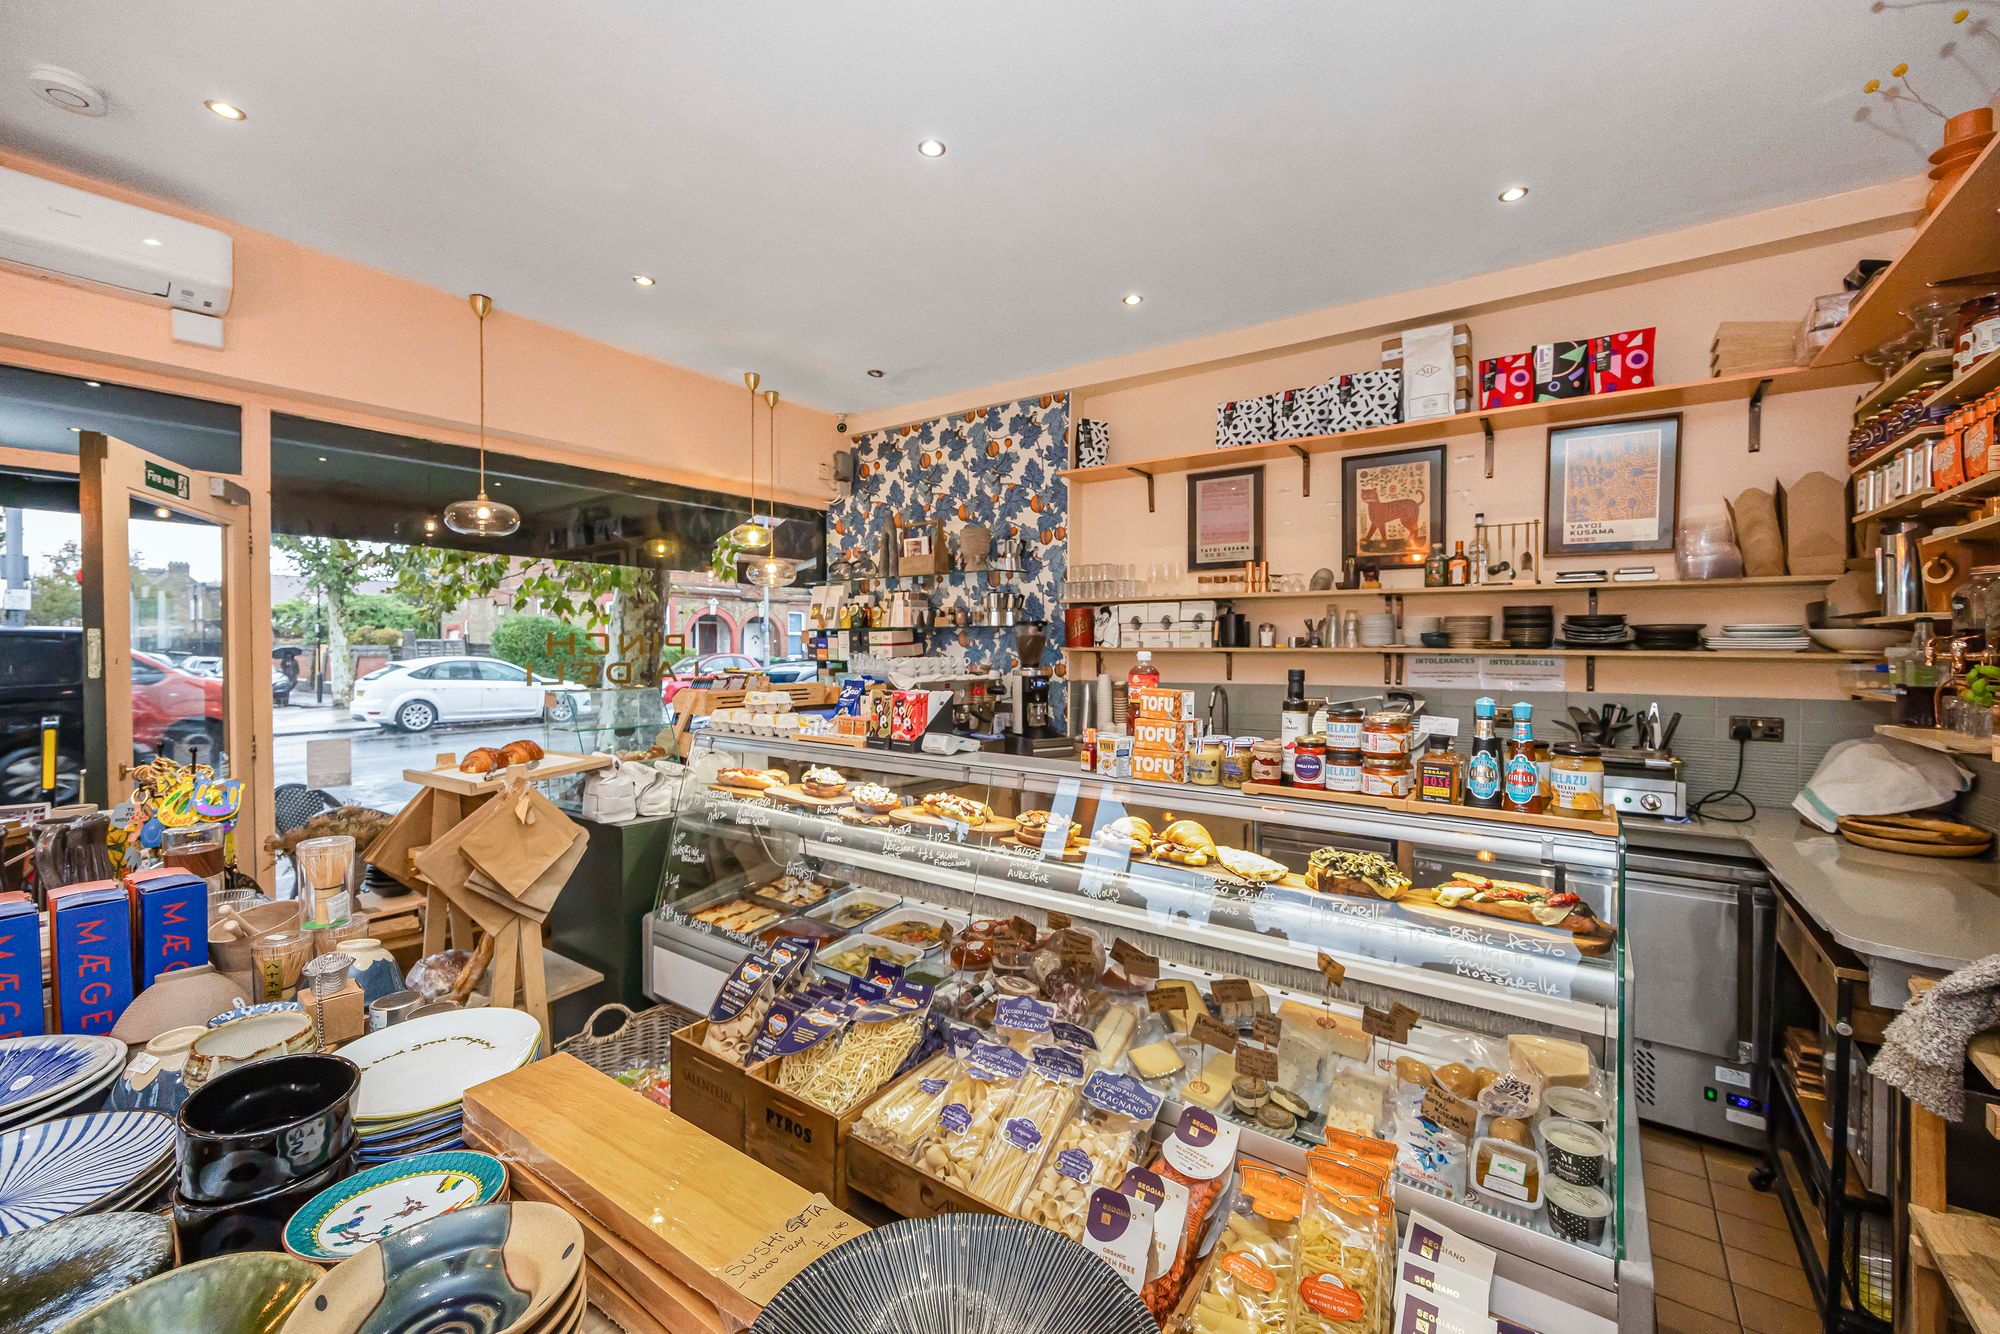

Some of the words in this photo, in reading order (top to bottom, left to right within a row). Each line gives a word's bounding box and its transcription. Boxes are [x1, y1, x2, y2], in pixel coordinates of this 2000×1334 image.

[147, 469, 162, 484] Fire
[1569, 528, 1615, 537] KUSAMA
[1570, 522, 1602, 530] YAYOI
[1415, 657, 1476, 665] INTOLERANCES
[1489, 658, 1556, 667] INTOLERANCES
[1141, 695, 1175, 713] TOFU
[1136, 725, 1177, 744] TOFU
[1327, 724, 1357, 733] BELAZU
[1133, 755, 1175, 775] TOFU
[1326, 767, 1356, 777] BELAZU
[1551, 771, 1587, 786] BELAZU
[1001, 1006, 1023, 1016] VECCHIO
[1001, 1013, 1047, 1029] GRAGNANO
[975, 1055, 1021, 1076] GRAGNANO
[1093, 1085, 1148, 1116] GRAGNANO
[1095, 1078, 1122, 1092] VECCHIO
[1121, 1088, 1153, 1110] PASTIFICIO
[766, 1107, 812, 1144] PYROS
[1191, 1118, 1222, 1136] SEGGIANO
[1137, 1181, 1171, 1200] SEGGIANO
[785, 1204, 828, 1233] GETA
[1102, 1203, 1137, 1220] SEGGIANO
[748, 1257, 779, 1281] WOOD
[780, 1236, 807, 1254] TRAY
[1102, 1247, 1127, 1261] ORGANIC
[1422, 1236, 1466, 1263] SEGGIANO
[1118, 1261, 1136, 1275] FREE
[1414, 1275, 1460, 1299] SEGGIANO
[1416, 1308, 1465, 1334] SEGGIANO
